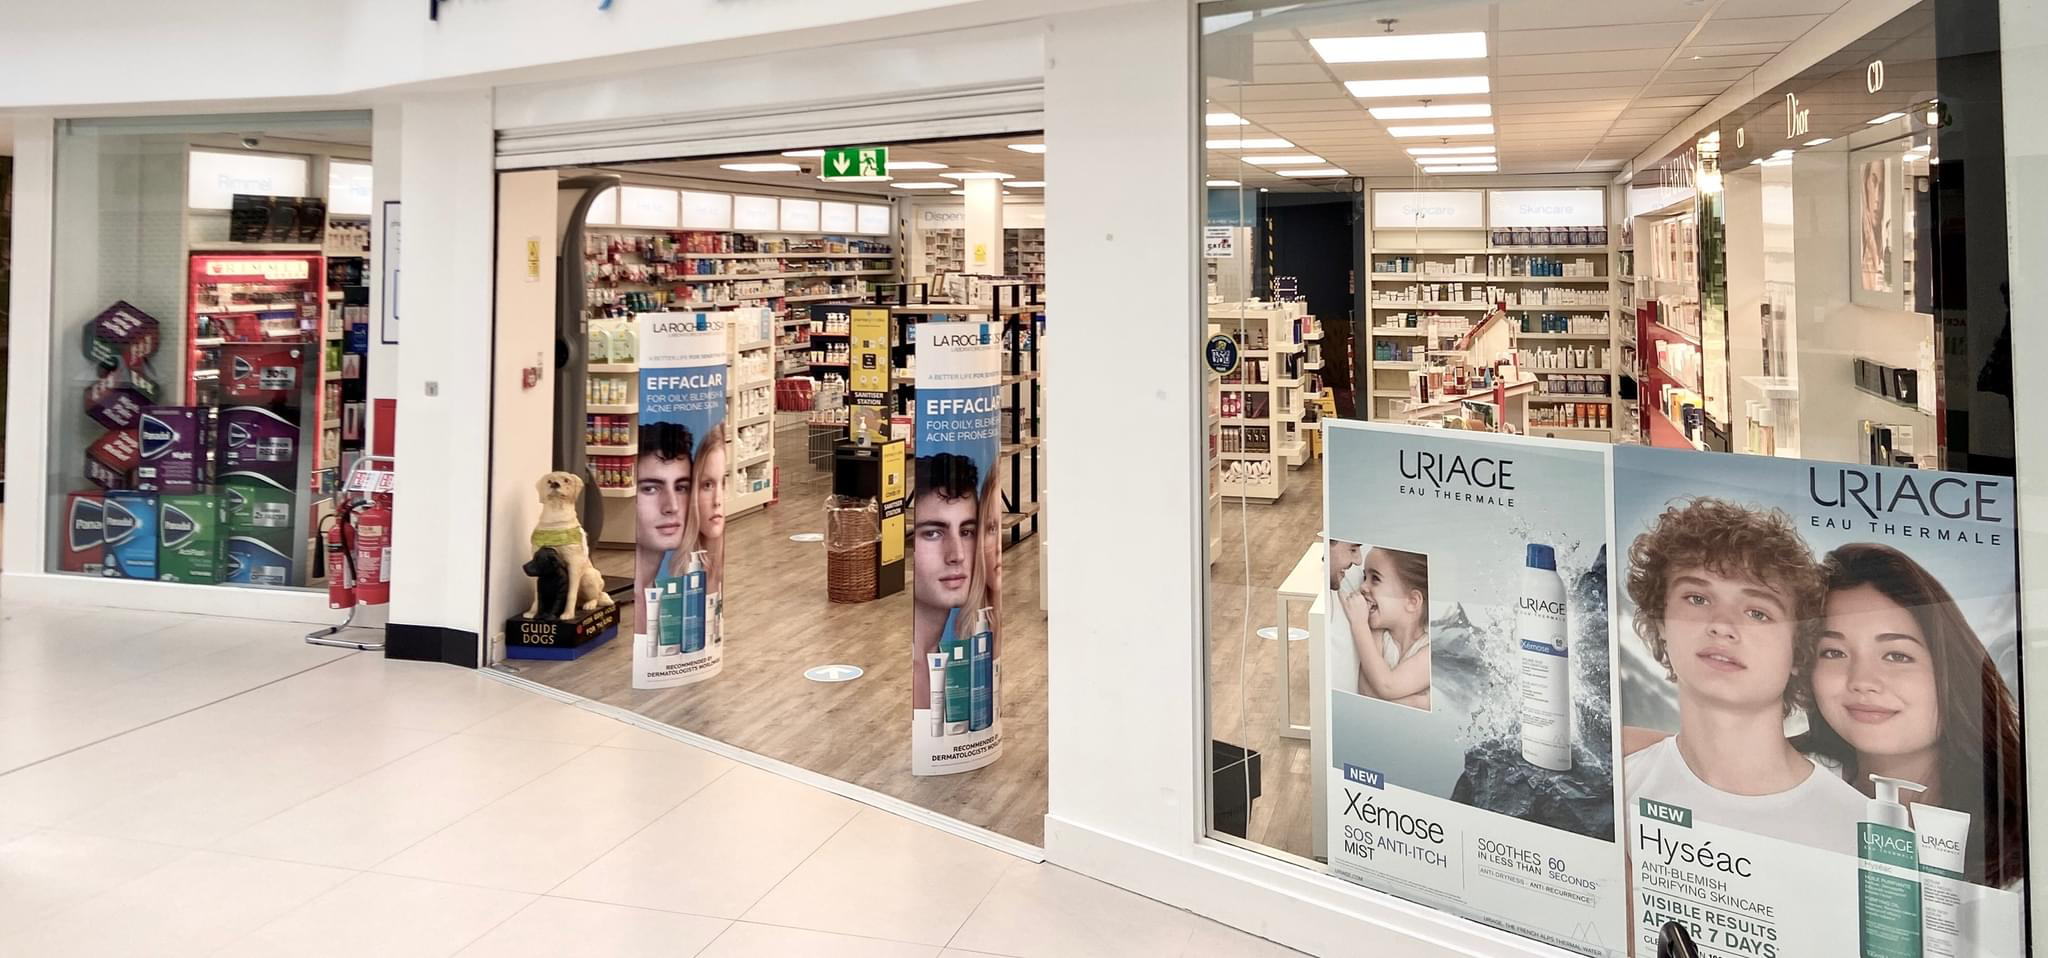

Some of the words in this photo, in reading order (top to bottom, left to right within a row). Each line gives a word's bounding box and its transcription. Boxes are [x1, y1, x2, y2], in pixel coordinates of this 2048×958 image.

[1867, 60, 1884, 93] CD
[1786, 93, 1809, 139] Dior
[924, 211, 965, 223] Dispen
[1519, 203, 1574, 216] Skincare
[653, 322, 668, 333] LA
[933, 335, 949, 346] LA
[647, 373, 722, 390] EFFACLAR
[647, 394, 666, 403] FOR
[854, 391, 884, 399] SANITISER
[926, 395, 1000, 415] EFFACLAR
[646, 404, 672, 413] ACNE
[673, 402, 703, 411] PRONE
[926, 421, 949, 431] FOR
[926, 432, 956, 442] ACNE
[957, 430, 986, 441] PRONE
[1399, 449, 1515, 490] URIAGE
[1400, 486, 1426, 496] EAU
[1434, 489, 1515, 508] THERMALE
[1810, 466, 2002, 523] URIAGE
[1811, 515, 1852, 530] EAU
[1869, 521, 2001, 546] THERMALE
[1519, 596, 1566, 616] URIAGE
[521, 623, 557, 634] GUIDE
[523, 634, 555, 645] DOGS
[647, 666, 698, 678] DERMATOLOGISTS
[666, 658, 706, 670] RECOMMENDED
[931, 747, 987, 761] DERMATOLOGISTS
[953, 736, 995, 752] RECOMMENDED
[1350, 767, 1378, 785] NEW
[1344, 787, 1444, 844] Xémose
[1647, 803, 1684, 823] NEW
[1344, 825, 1373, 845] SOS
[1377, 836, 1447, 868] ANTI-ITCH
[1344, 839, 1375, 861] MIST
[1478, 837, 1541, 866] SOOTHES
[1640, 823, 1752, 878] Hyséac
[1863, 831, 1914, 854] URIAGE
[1921, 834, 1960, 851] URIAGE
[1478, 851, 1487, 860] IN
[1489, 853, 1513, 868] LESS
[1516, 861, 1542, 876] THAN
[1548, 857, 1565, 872] 60
[1641, 860, 1727, 892] ANTI-BLEMISH
[1641, 872, 1707, 899] PURIFYING
[1709, 891, 1775, 918] SKINCARE
[1641, 892, 1701, 920] VISIBLE
[1705, 910, 1777, 941] RESULTS
[1642, 910, 1702, 940] AFR
[1708, 928, 1718, 943] 7
[1505, 922, 1516, 930] THE
[1516, 926, 1539, 936] FRENCH
[1555, 937, 1582, 950] THERMAL
[1582, 946, 1602, 956] WATER
